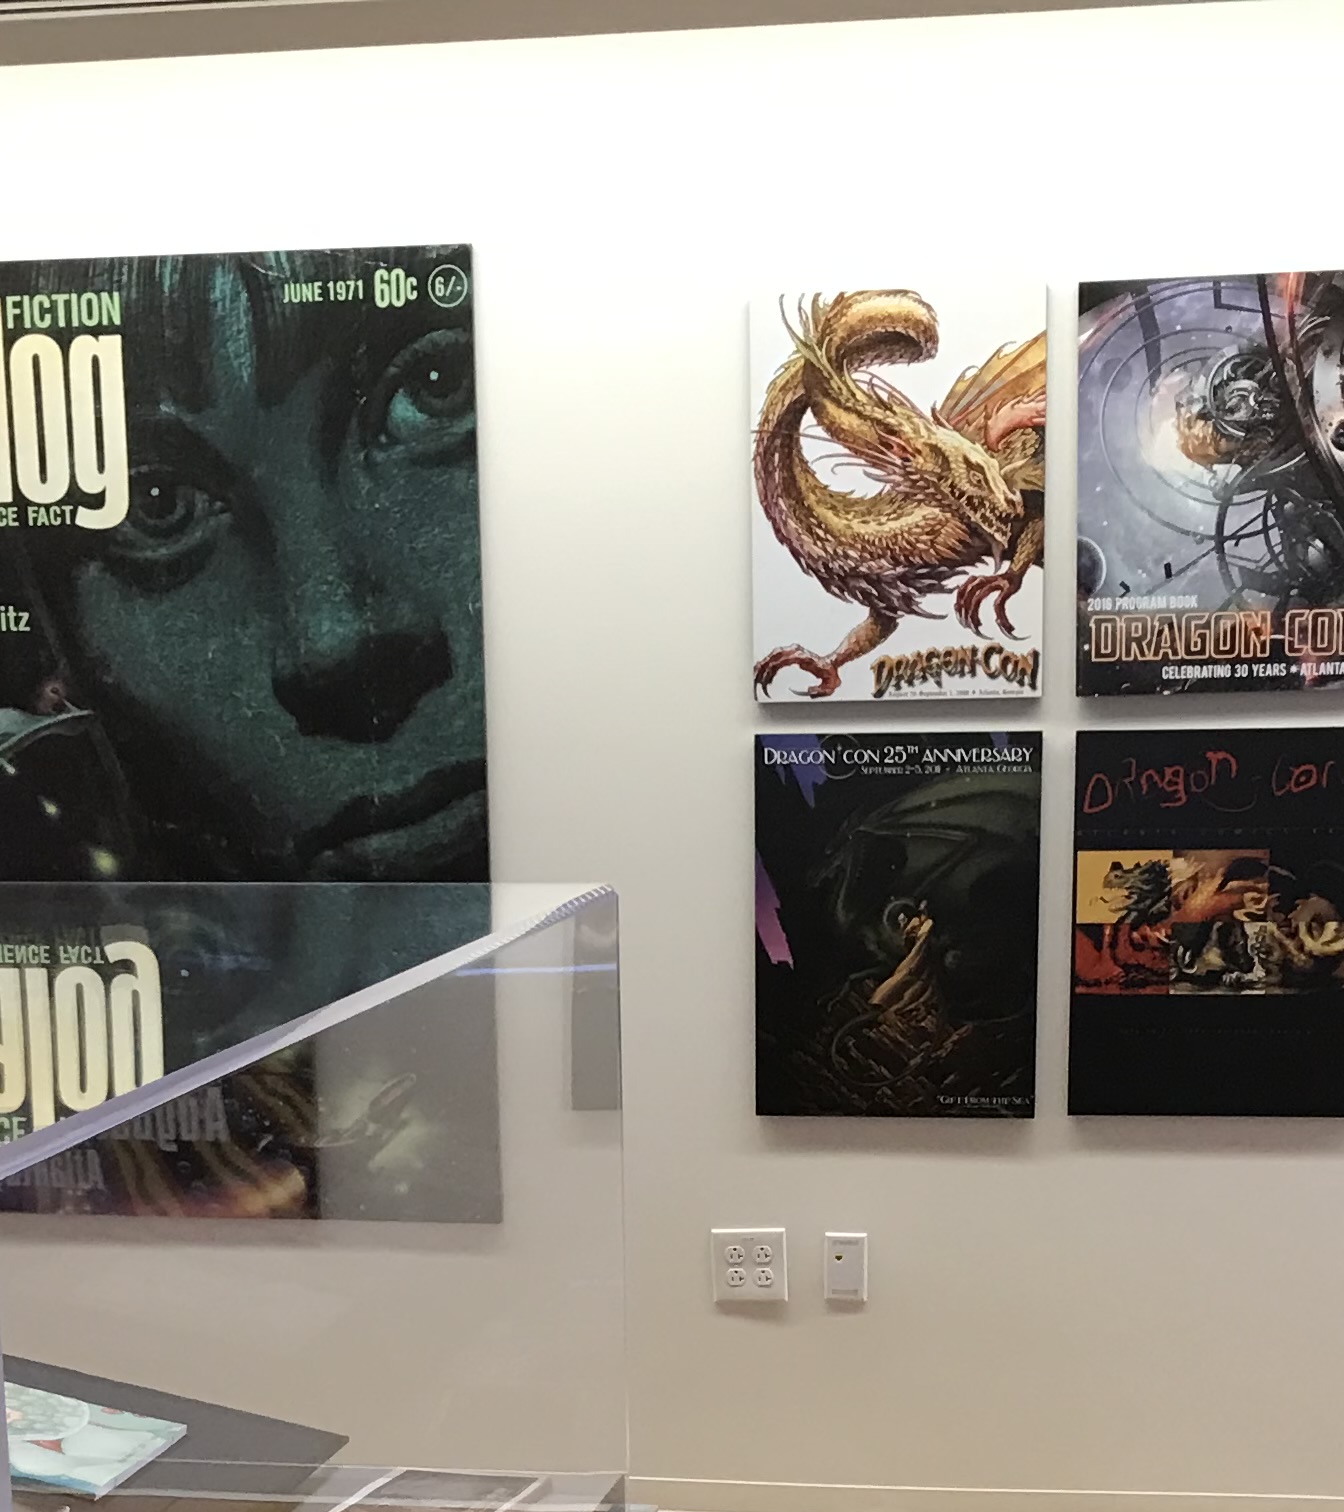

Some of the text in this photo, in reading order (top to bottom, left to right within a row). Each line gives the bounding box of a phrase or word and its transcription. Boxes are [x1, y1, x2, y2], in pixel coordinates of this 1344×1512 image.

[283, 280, 324, 303] JUNE
[327, 279, 364, 301] 1971
[5, 292, 122, 330] FICTION
[27, 505, 74, 527] FACT
[1089, 608, 1272, 663] DRAGON
[1161, 664, 1232, 680] CELEBRATING
[1234, 663, 1249, 678] 30
[1251, 662, 1287, 678] YEARS
[921, 747, 1034, 764] ANNIVERSARY
